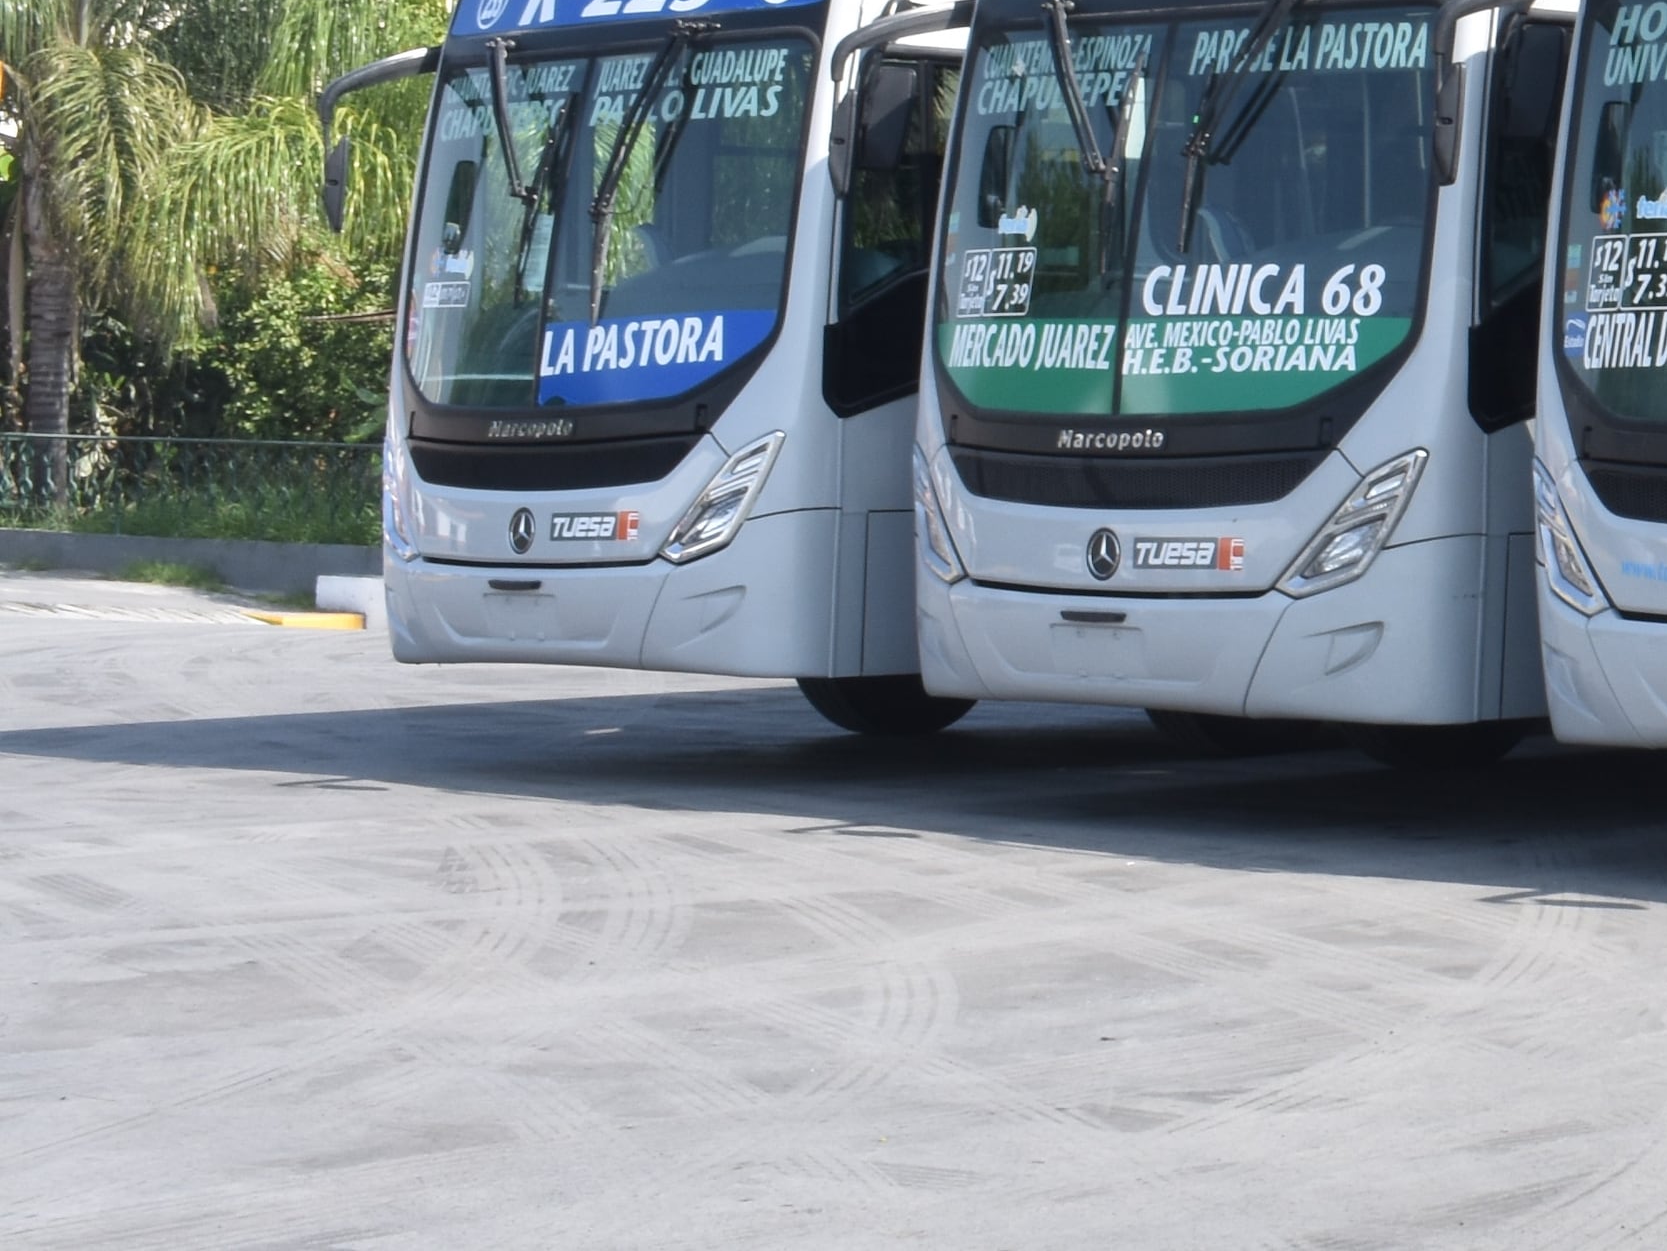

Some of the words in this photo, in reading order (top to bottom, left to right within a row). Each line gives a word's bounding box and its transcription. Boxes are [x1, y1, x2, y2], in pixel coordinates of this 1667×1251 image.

[1279, 25, 1310, 71] LA
[1315, 22, 1428, 70] PASTORA
[594, 58, 651, 100] JUAREZ
[690, 85, 783, 120] LIVAS
[1594, 240, 1623, 272] $12
[1142, 263, 1305, 316] CLINICA
[1322, 263, 1386, 316] 68
[541, 329, 574, 376] LA
[583, 315, 724, 371] PASTORA
[948, 323, 1034, 369] MERCADO
[1035, 323, 1115, 371] JUAREZ
[1124, 322, 1158, 349] AVE.
[1163, 319, 1299, 348] MEXICO-PABLO
[1304, 318, 1360, 345] LIVAS
[1584, 312, 1655, 370] CENTRAL
[1122, 345, 1357, 376] H.E.B.-SORIANA
[488, 421, 574, 442] Marcopolo
[1058, 428, 1164, 450] Marcopolo
